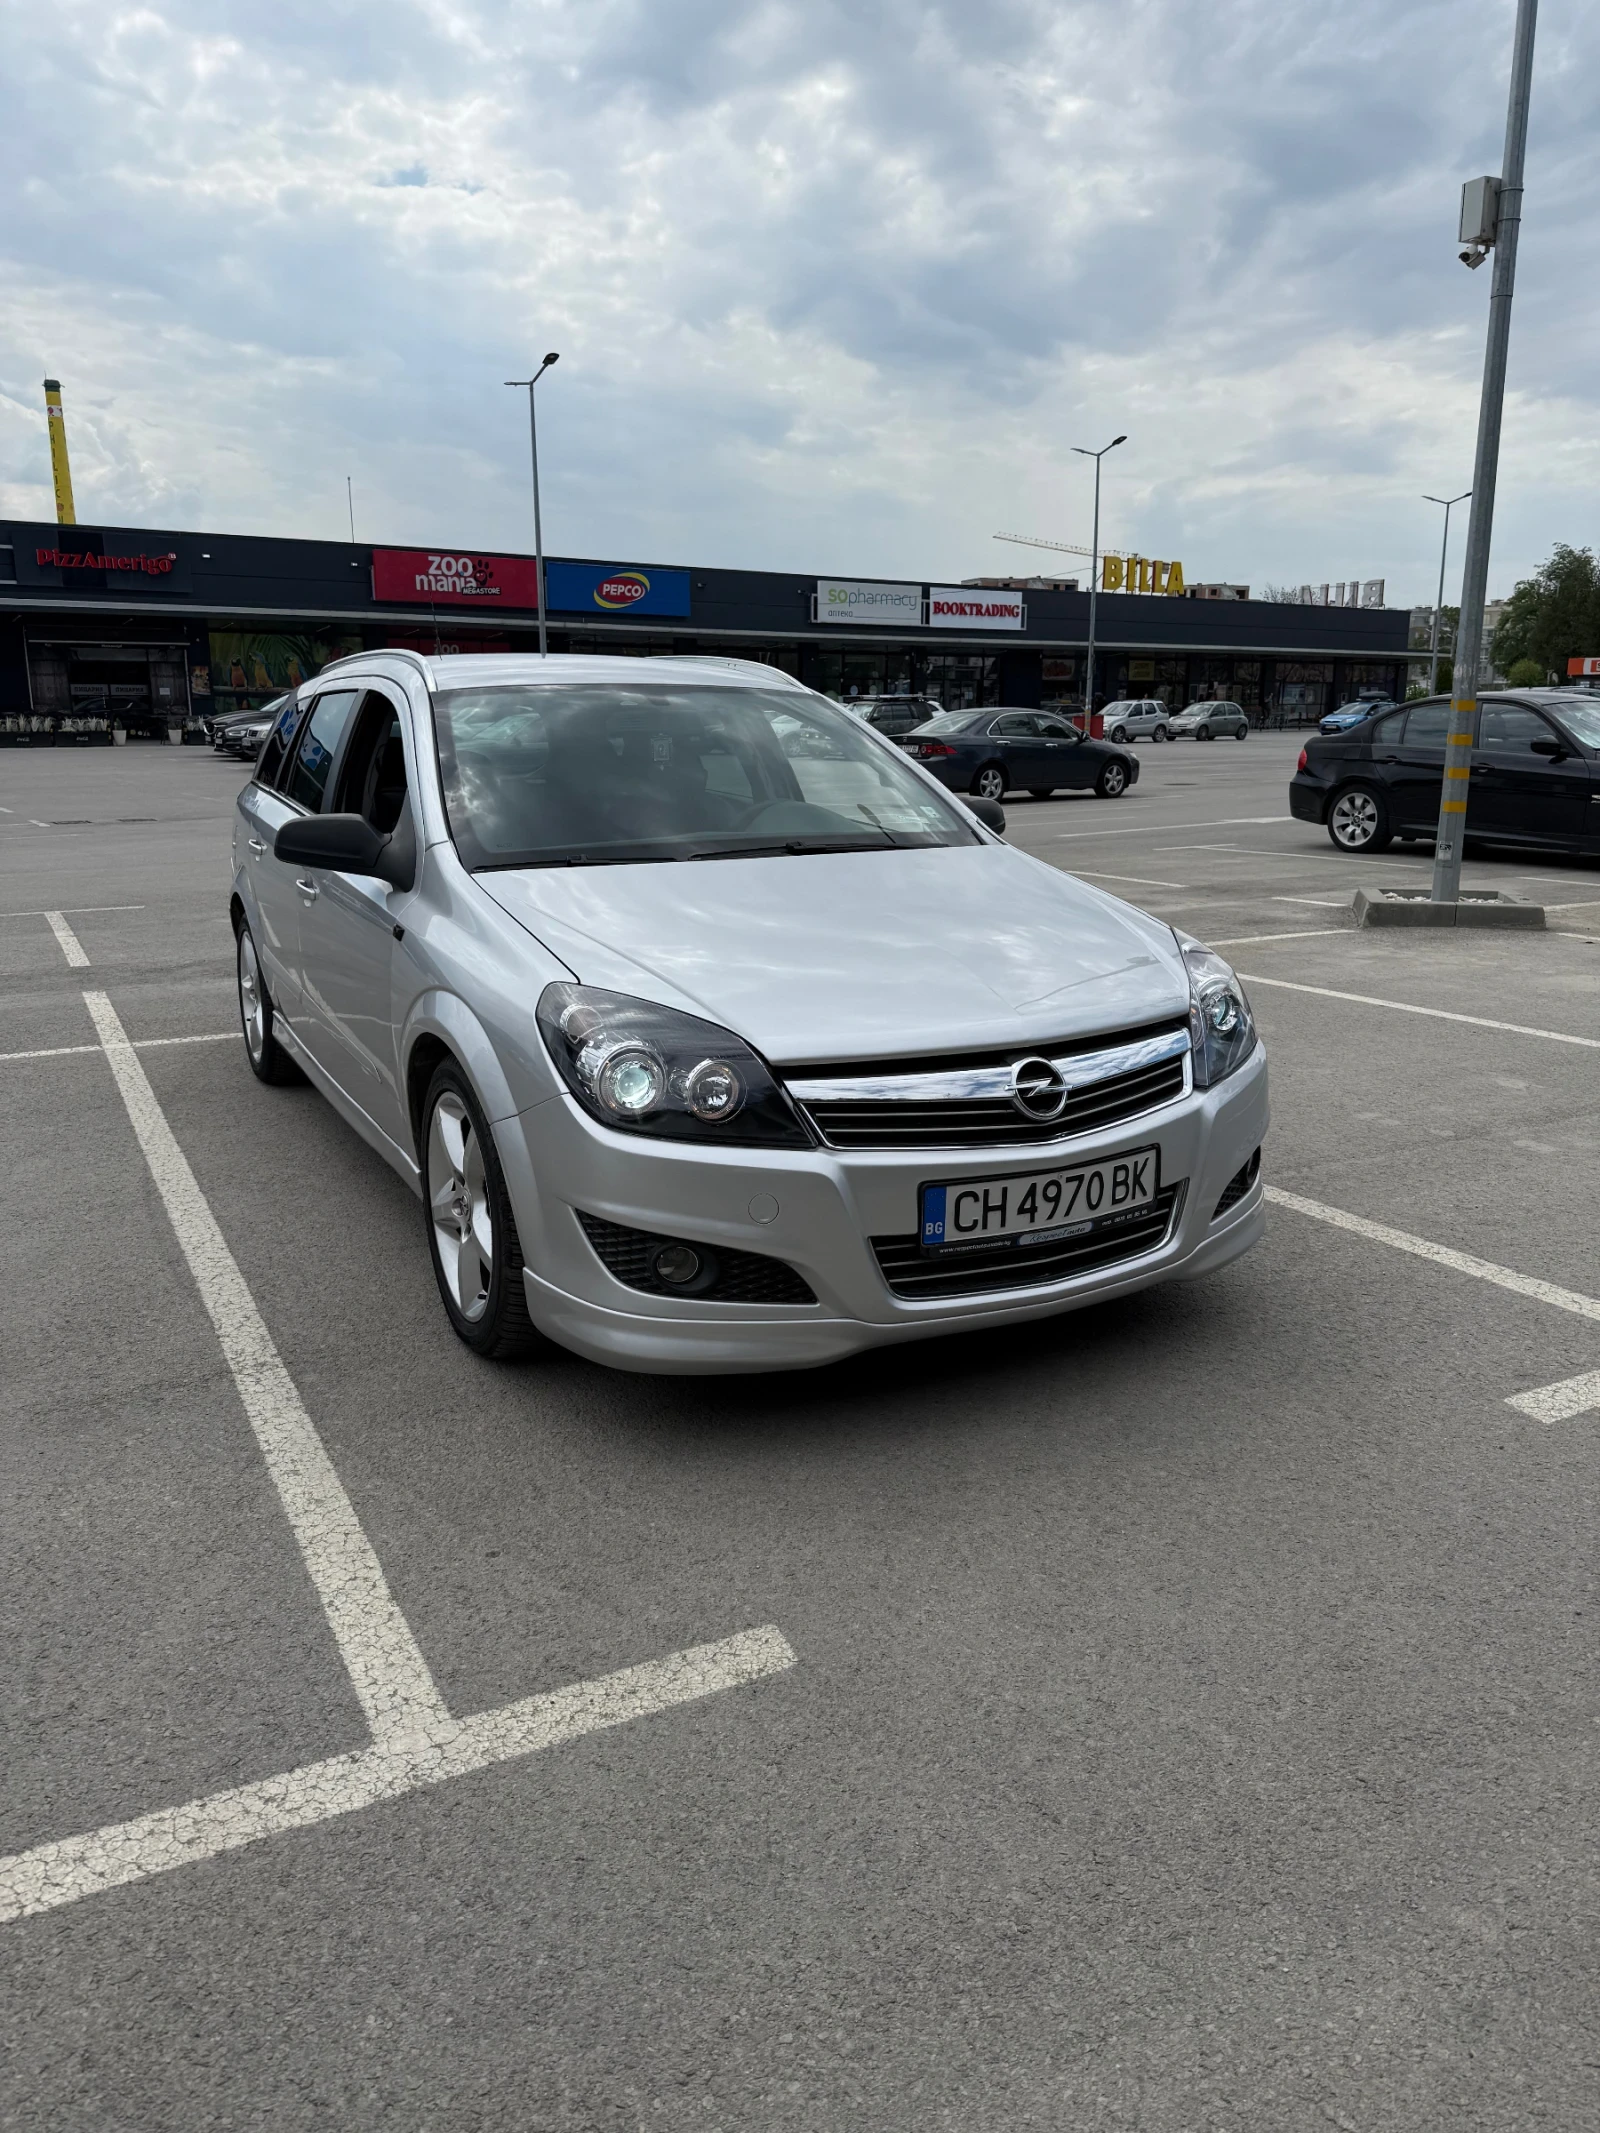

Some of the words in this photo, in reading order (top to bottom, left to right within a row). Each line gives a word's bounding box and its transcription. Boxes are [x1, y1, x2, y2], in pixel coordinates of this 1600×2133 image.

[36, 548, 172, 575] PizzAmerigo
[415, 574, 477, 592] mania
[1102, 555, 1184, 595] BILLA
[463, 587, 501, 595] MEGASTORE
[602, 583, 642, 597] PEPCO
[828, 609, 853, 618] аптека
[933, 601, 1020, 618] BOOKTRADING
[954, 1186, 1008, 1233] CH
[1017, 1170, 1105, 1223] 4970
[1111, 1157, 1150, 1206] BK
[925, 1222, 943, 1235] BG
